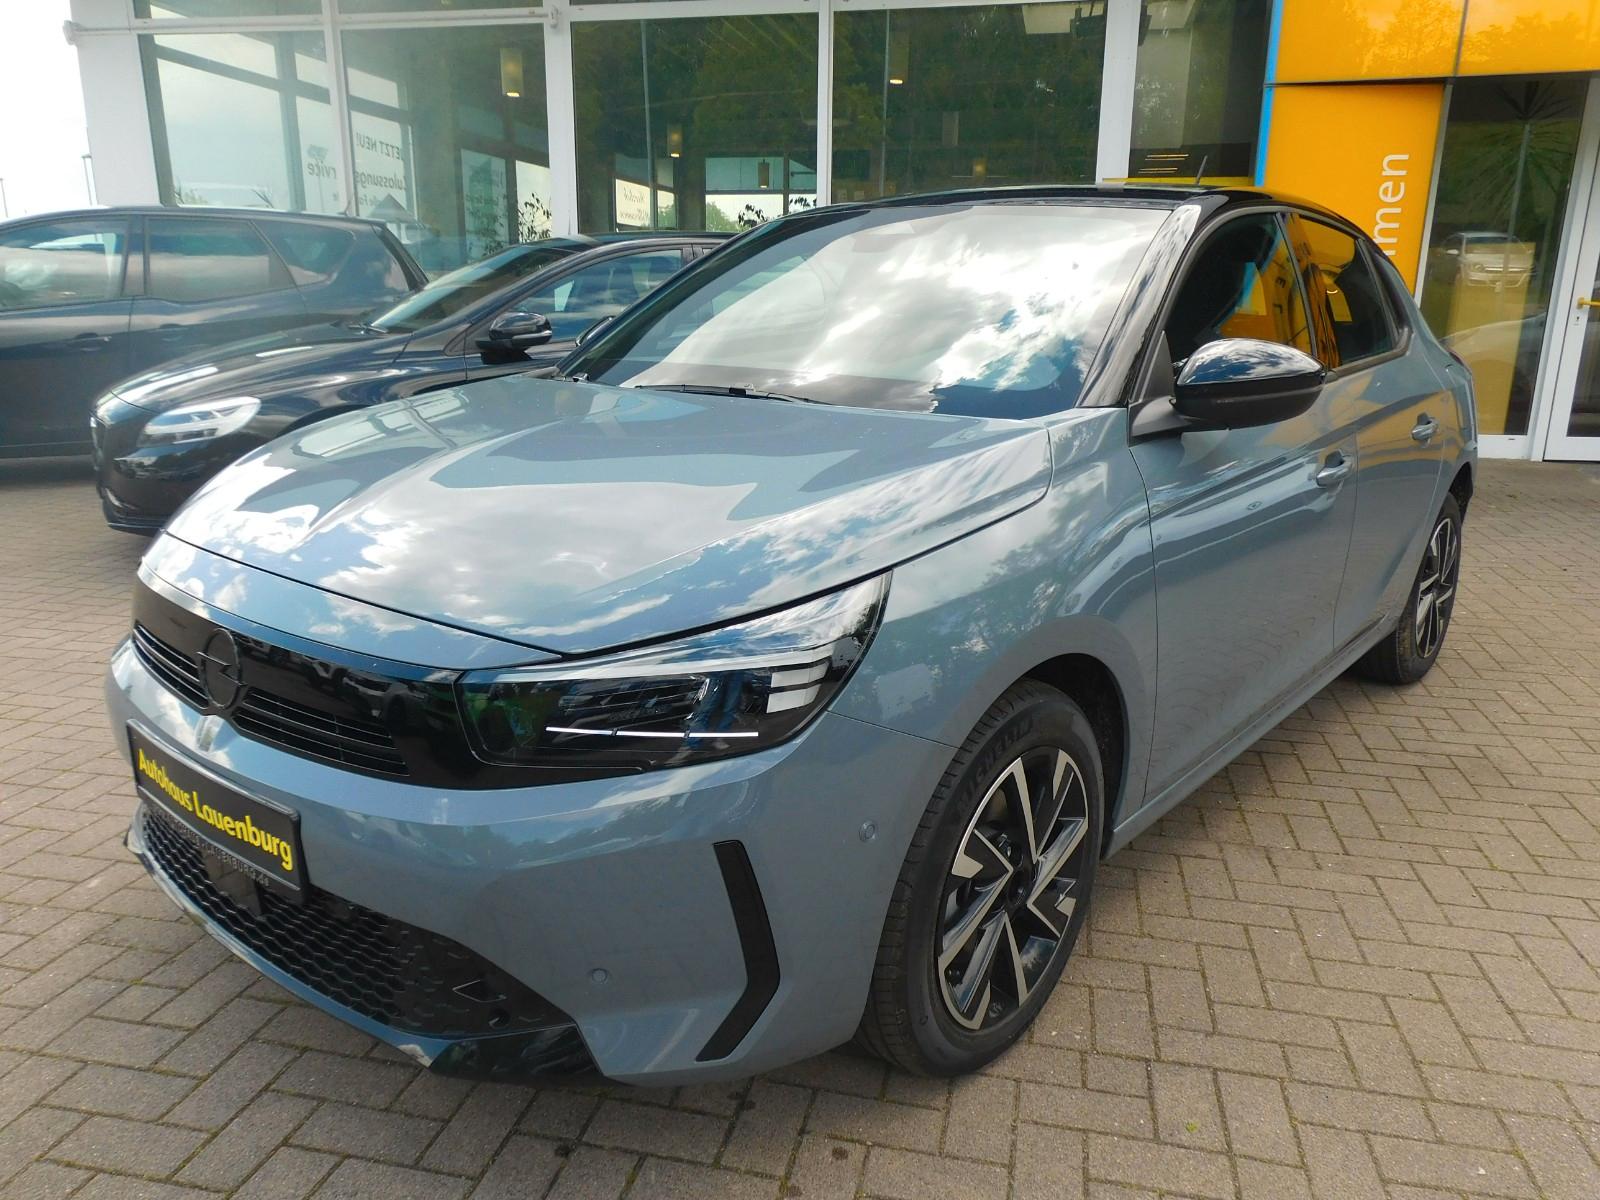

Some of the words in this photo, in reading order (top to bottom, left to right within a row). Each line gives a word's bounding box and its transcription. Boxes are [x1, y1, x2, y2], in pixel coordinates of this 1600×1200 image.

[1372, 153, 1409, 256] men
[137, 748, 193, 812] Autohaus
[192, 790, 294, 871] Lauenburg
